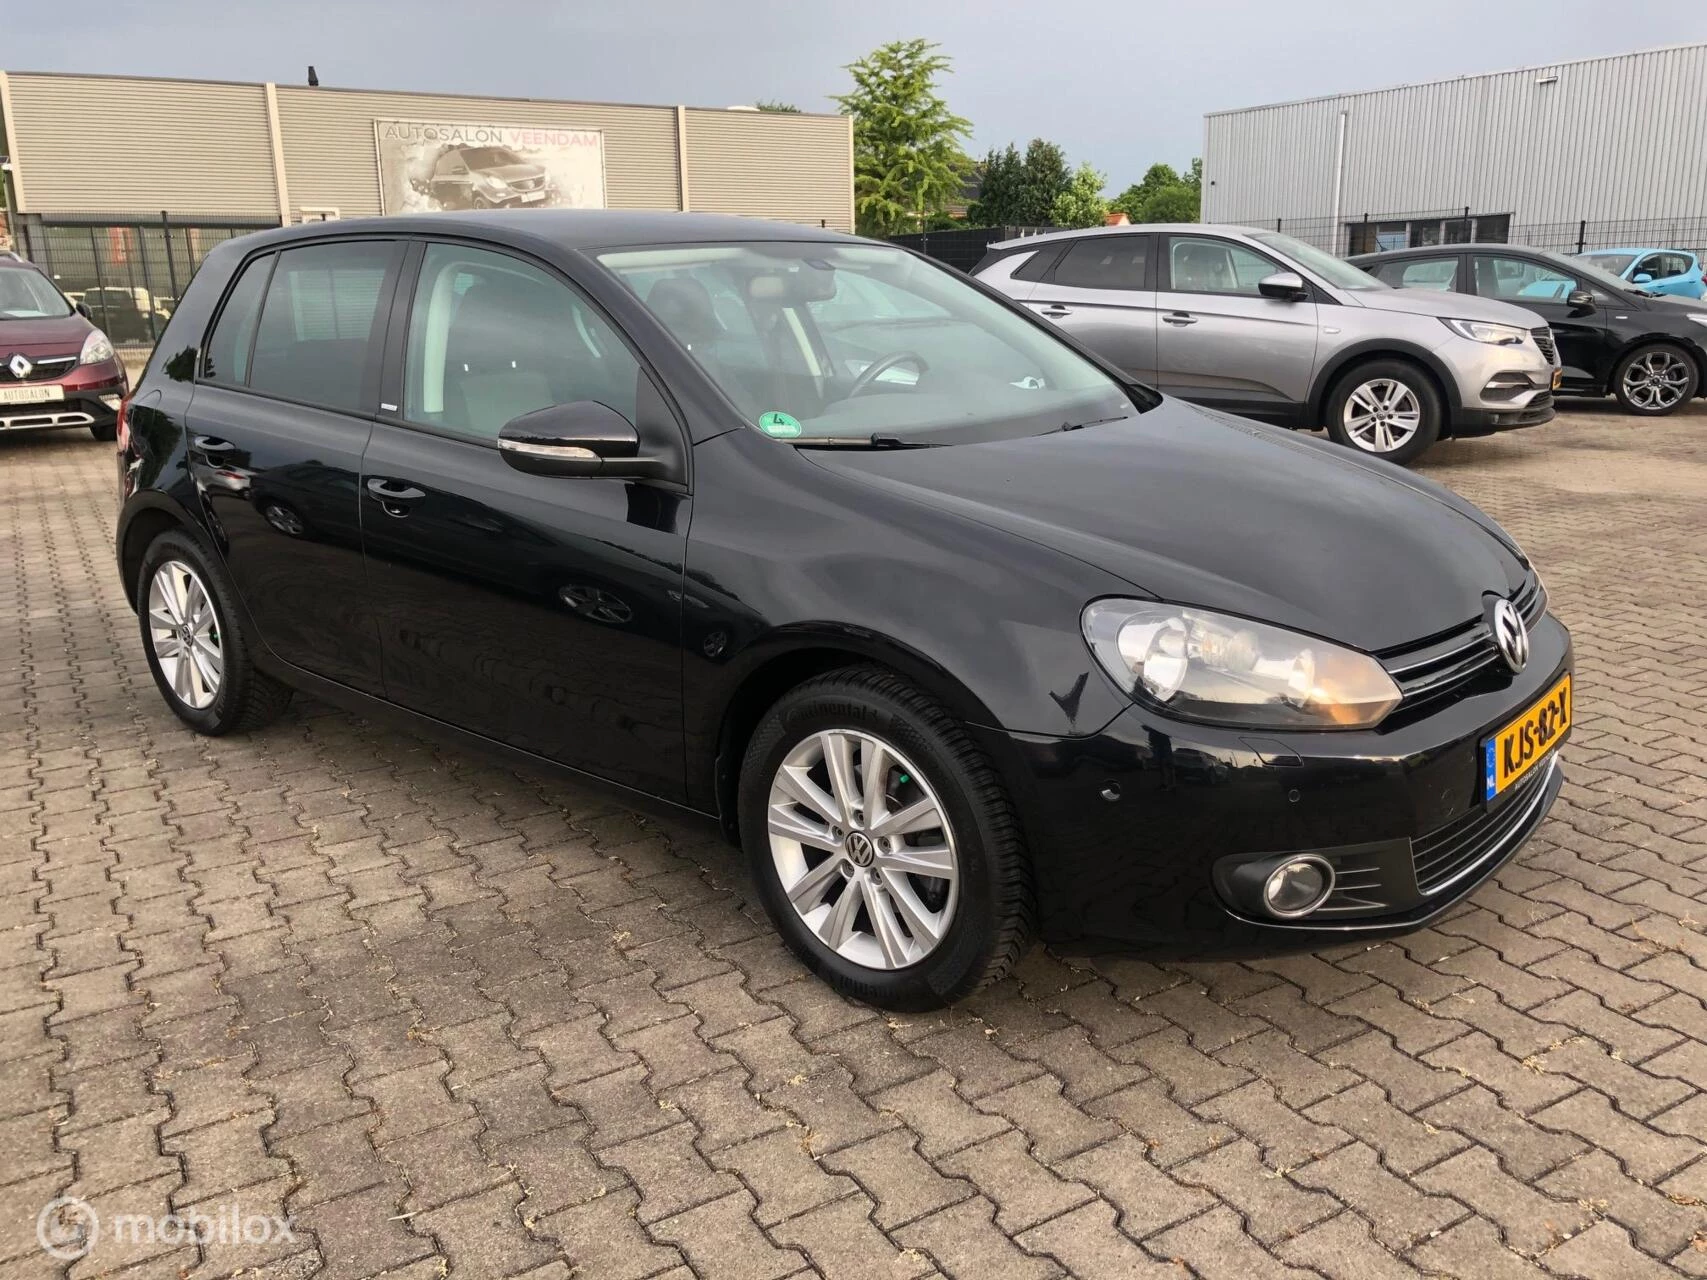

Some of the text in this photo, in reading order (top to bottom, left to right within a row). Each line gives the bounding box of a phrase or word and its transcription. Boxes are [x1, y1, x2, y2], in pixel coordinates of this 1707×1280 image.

[384, 125, 598, 147] AUTOSALON VEENDAM
[3, 387, 50, 401] AUTOSALON
[773, 413, 785, 425] 4
[1503, 687, 1567, 779] KJS-82-X
